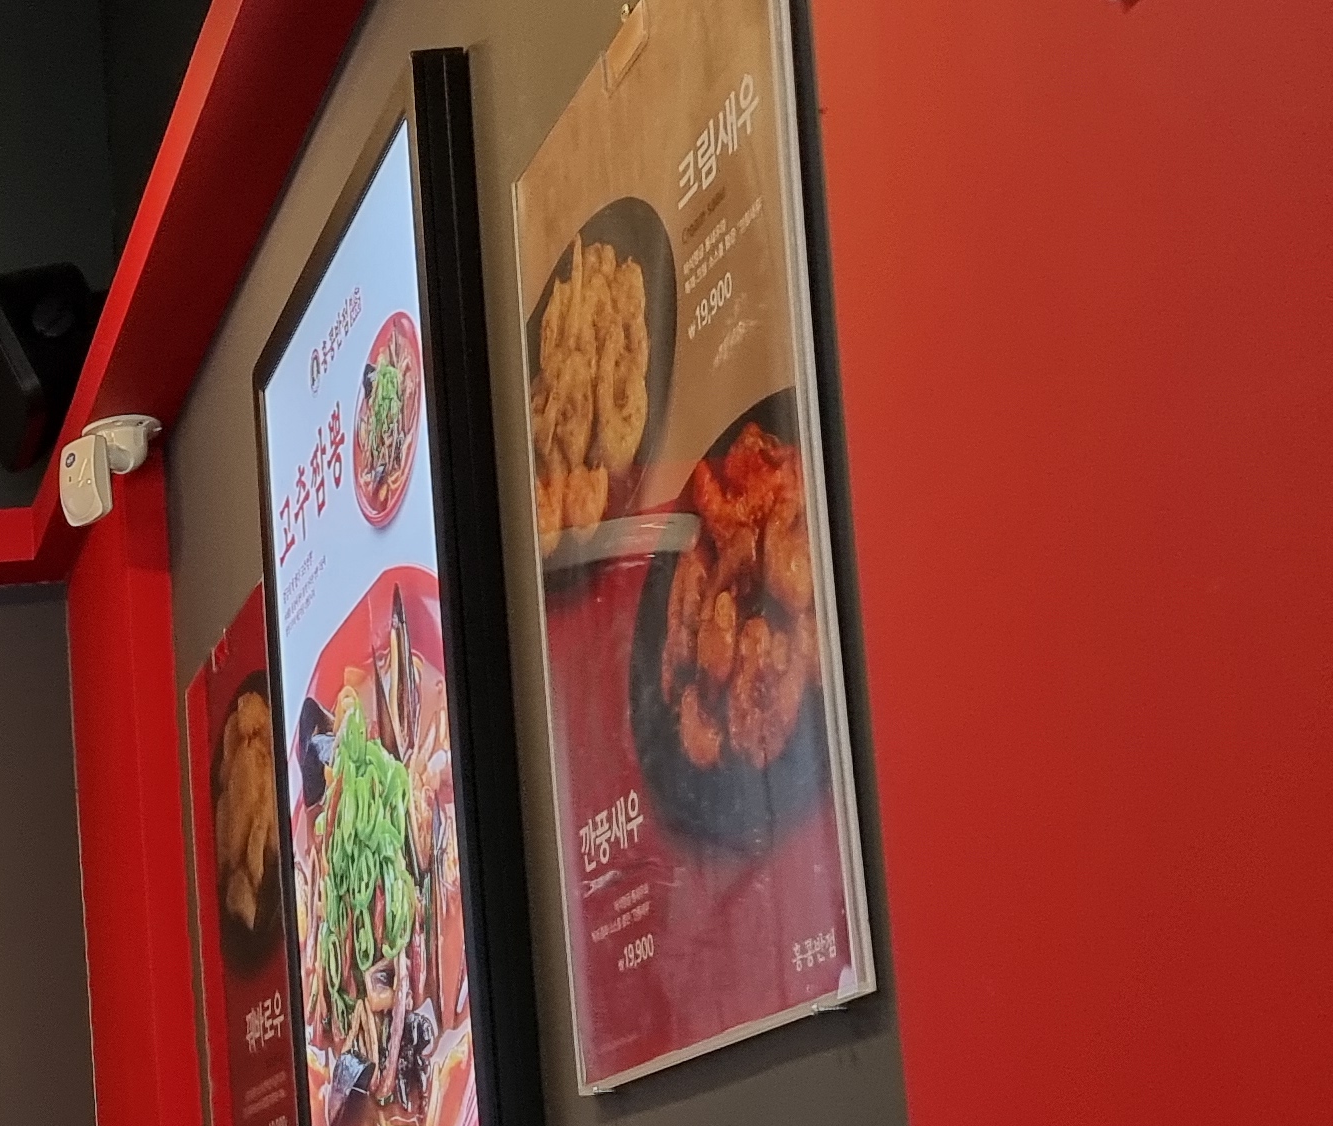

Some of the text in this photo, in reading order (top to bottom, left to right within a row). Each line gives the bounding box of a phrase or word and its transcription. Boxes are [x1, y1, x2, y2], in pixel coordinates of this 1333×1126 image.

[678, 73, 760, 210] 크림새우
[279, 401, 345, 568] 고추짬뽕
[579, 789, 644, 873] 깐풍새우
